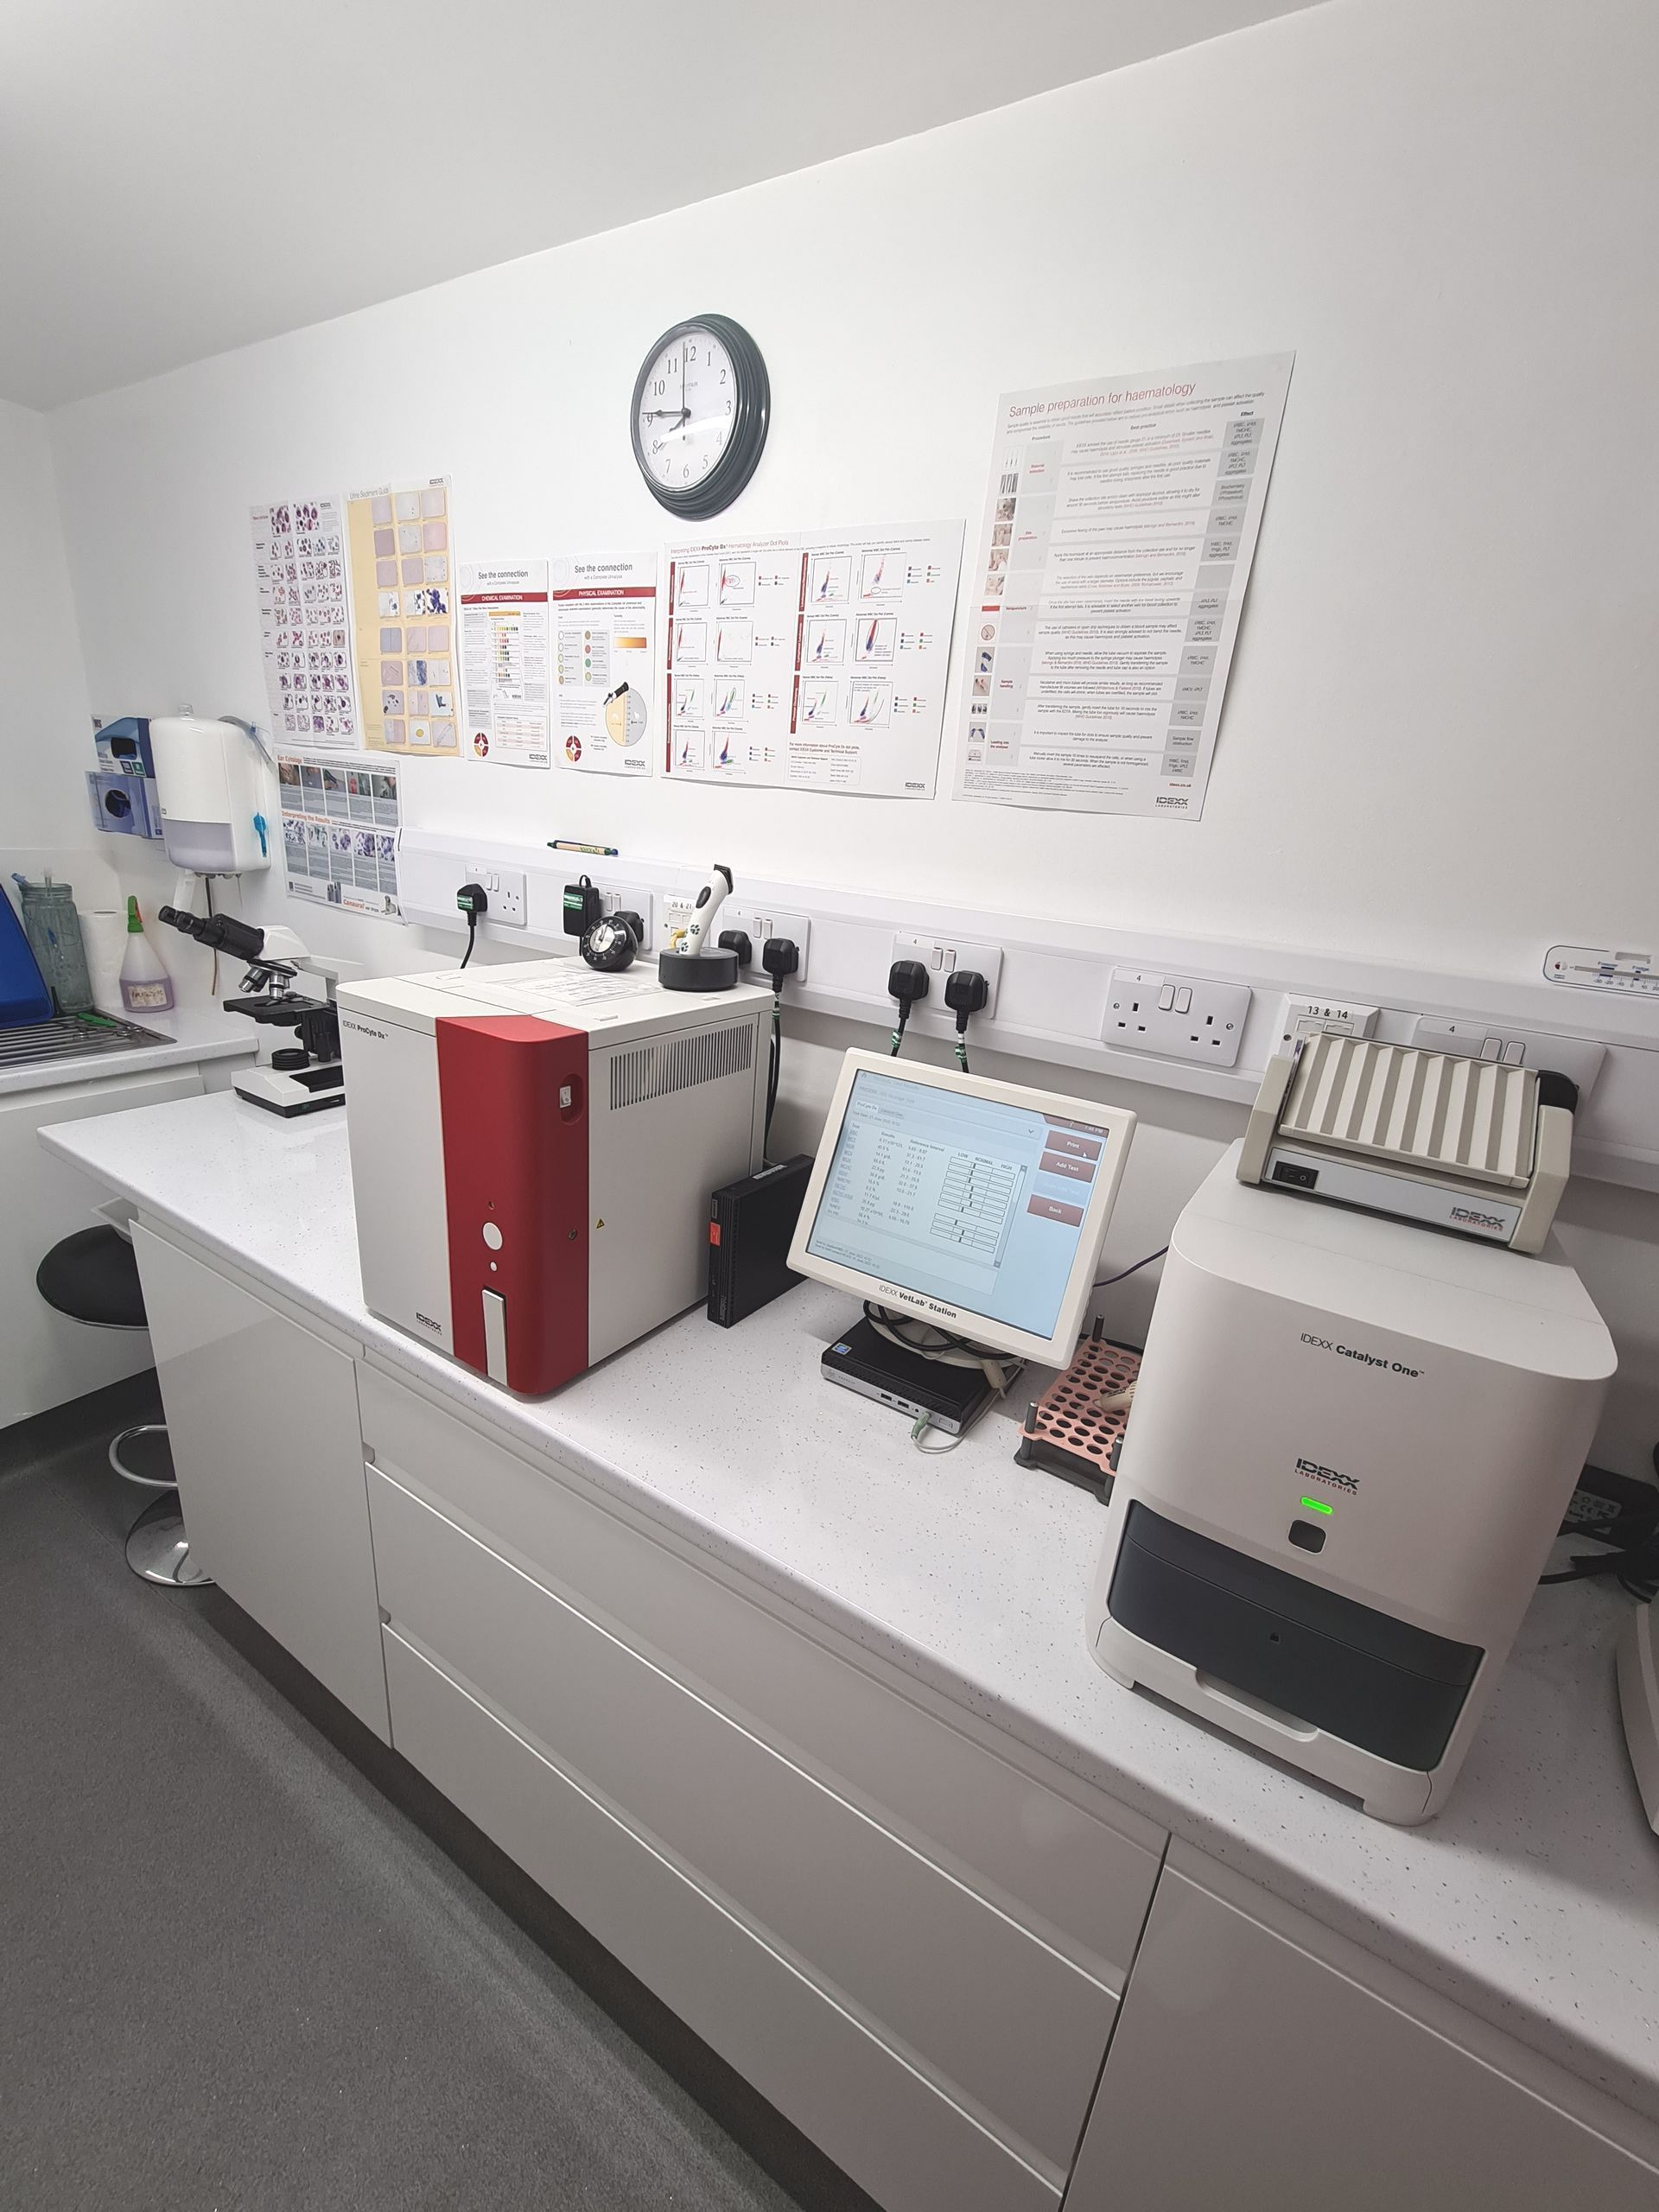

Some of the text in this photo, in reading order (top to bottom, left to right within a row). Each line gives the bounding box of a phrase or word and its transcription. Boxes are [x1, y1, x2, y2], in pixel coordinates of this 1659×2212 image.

[684, 346, 696, 362] 12
[707, 351, 711, 366] 1
[667, 358, 678, 374] 11
[719, 369, 726, 385] 2
[653, 379, 665, 397] 10
[725, 400, 732, 416] 3
[1009, 383, 1197, 417] Sample preparation for haematology
[647, 413, 653, 428] 9
[715, 431, 722, 446] 4
[652, 440, 658, 455] 8
[665, 459, 671, 474] 7
[702, 454, 709, 470] 5
[683, 463, 690, 479] 6
[498, 569, 528, 578] connection
[598, 563, 632, 572] connection
[285, 755, 302, 764] Cytology
[1156, 797, 1189, 805] IDEXX
[282, 810, 307, 821] Interpreting
[343, 899, 365, 909] Canaural
[1307, 1006, 1319, 1014] 13
[1337, 1010, 1348, 1020] 14
[343, 1020, 356, 1030] IDEXX
[357, 1025, 377, 1036] ProCyte
[975, 1157, 993, 1166] NORMAL
[1048, 1205, 1062, 1214] Back
[1452, 1207, 1505, 1228] IDEXX
[1449, 1215, 1503, 1231] LABORATORIES
[879, 1285, 898, 1296] IDEXX
[928, 1302, 957, 1319] Station
[416, 1313, 442, 1332] IDEXX
[1300, 1332, 1333, 1351] IDEXX
[1336, 1344, 1389, 1369] Catalyst
[1294, 1469, 1357, 1496] LABORATORIES
[1295, 1458, 1360, 1491] IDEXX
